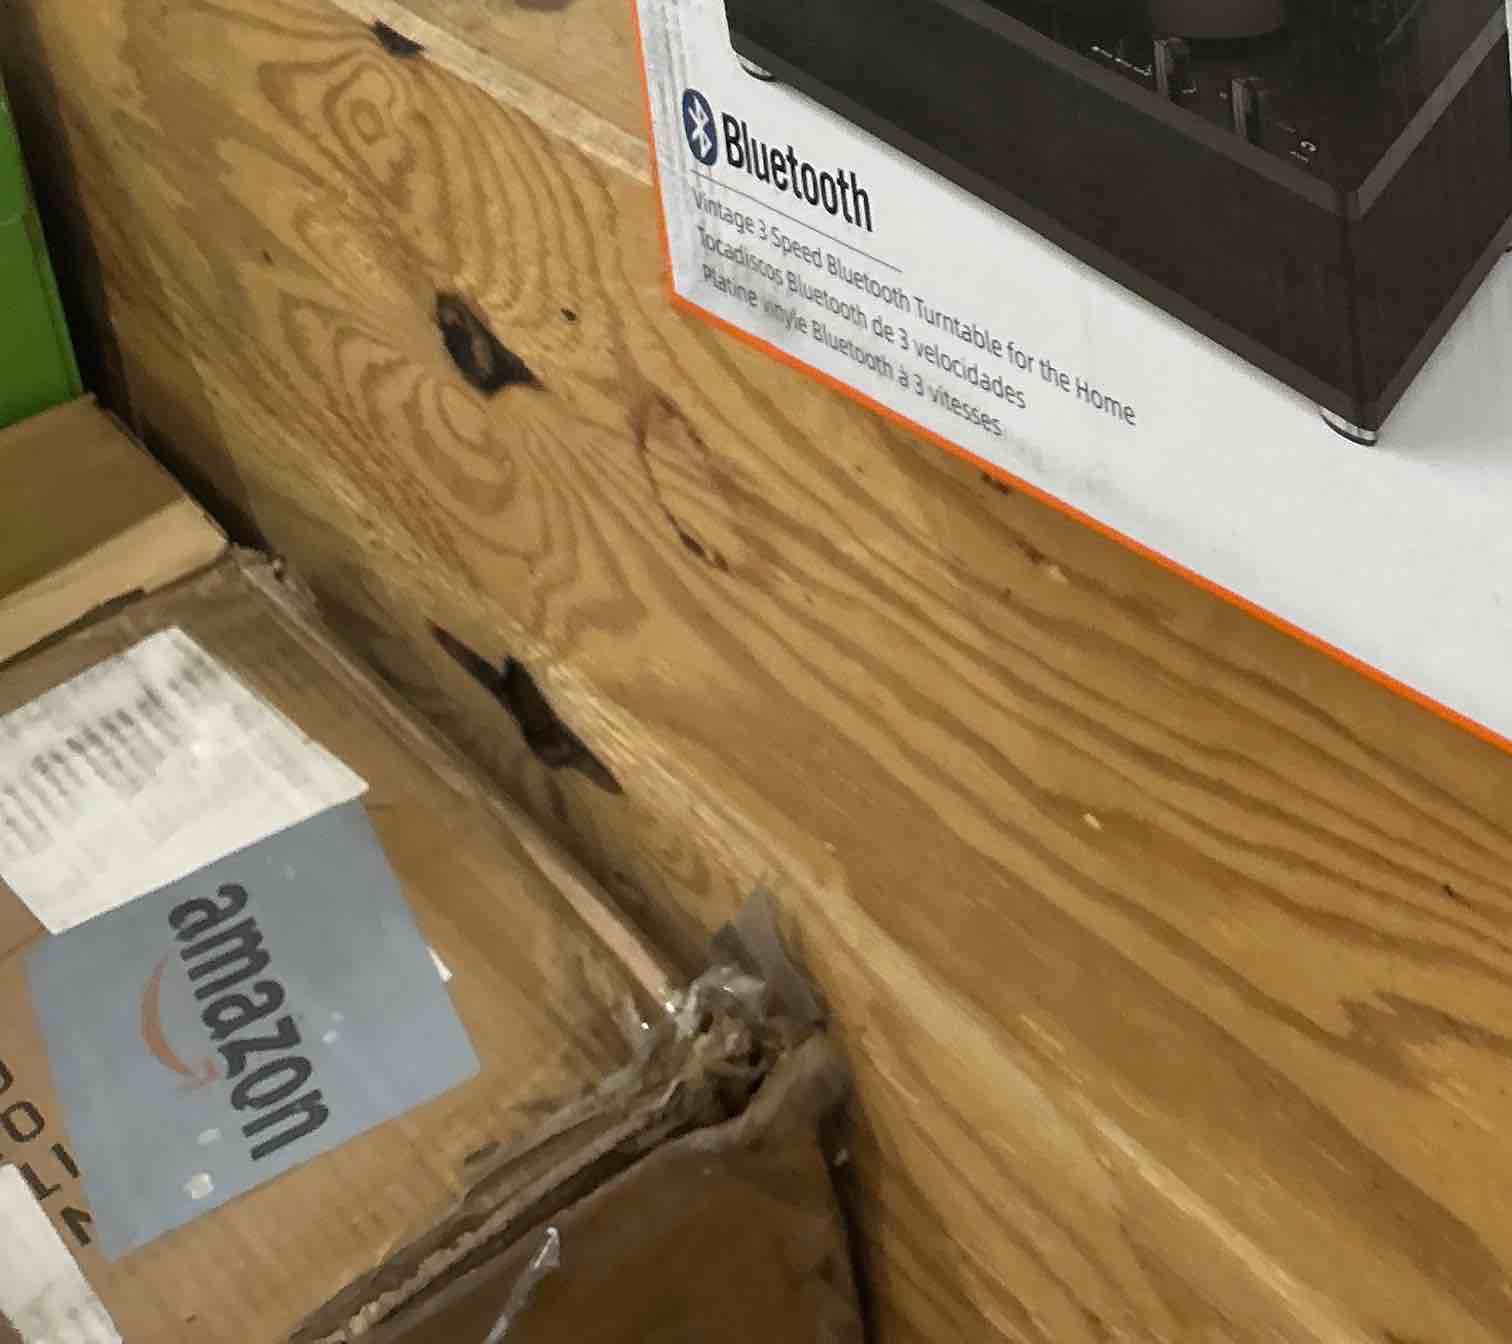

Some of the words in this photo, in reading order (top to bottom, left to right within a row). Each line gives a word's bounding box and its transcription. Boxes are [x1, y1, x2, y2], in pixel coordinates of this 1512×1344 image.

[722, 112, 872, 232] Bluetooth
[691, 187, 755, 235] Vintage
[759, 219, 768, 241] 3
[771, 226, 823, 269] Speed
[827, 253, 911, 312] Bluetooth
[914, 296, 1003, 358] Turntable
[1007, 341, 1035, 373] for
[1039, 359, 1070, 392] the
[1075, 377, 1136, 426] Home
[697, 224, 784, 286] Tocadiscos
[787, 271, 868, 329] Bluetooth
[871, 314, 895, 342] de
[899, 327, 909, 350] 3
[914, 338, 1026, 409] velocidades
[703, 263, 757, 308] Platine
[812, 319, 893, 380] Bluetooth
[913, 374, 924, 396] 3
[928, 384, 1002, 436] vitesses
[168, 882, 330, 1163] amazon
